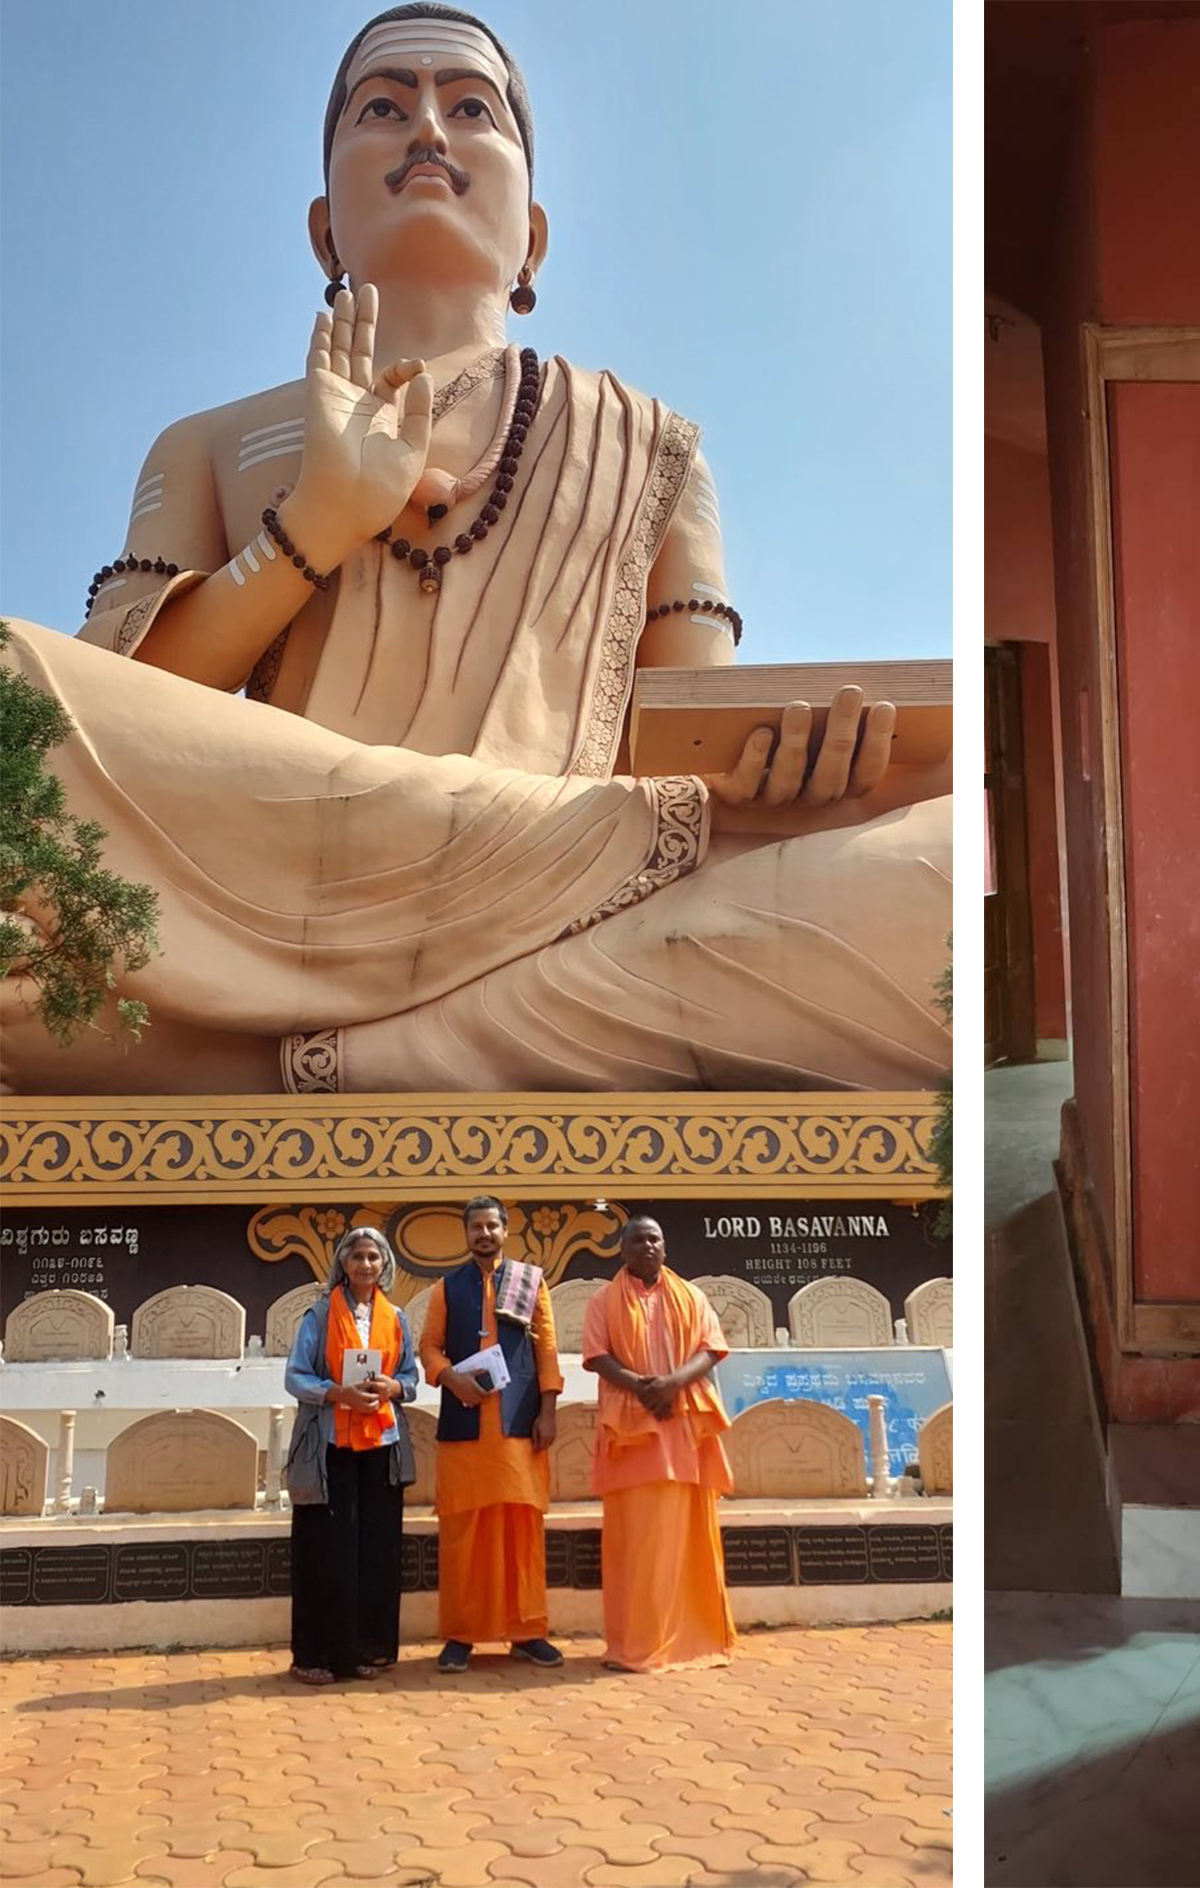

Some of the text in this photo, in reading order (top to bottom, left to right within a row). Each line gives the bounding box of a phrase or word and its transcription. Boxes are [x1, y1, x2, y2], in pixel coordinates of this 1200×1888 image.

[703, 1216, 890, 1238] LORD BASAVANNA
[80, 1225, 139, 1254] ಬಸವಣ್ಣ
[770, 1242, 827, 1254] 1134-1196
[745, 1258, 853, 1270] HEIGHT 108 FEET
